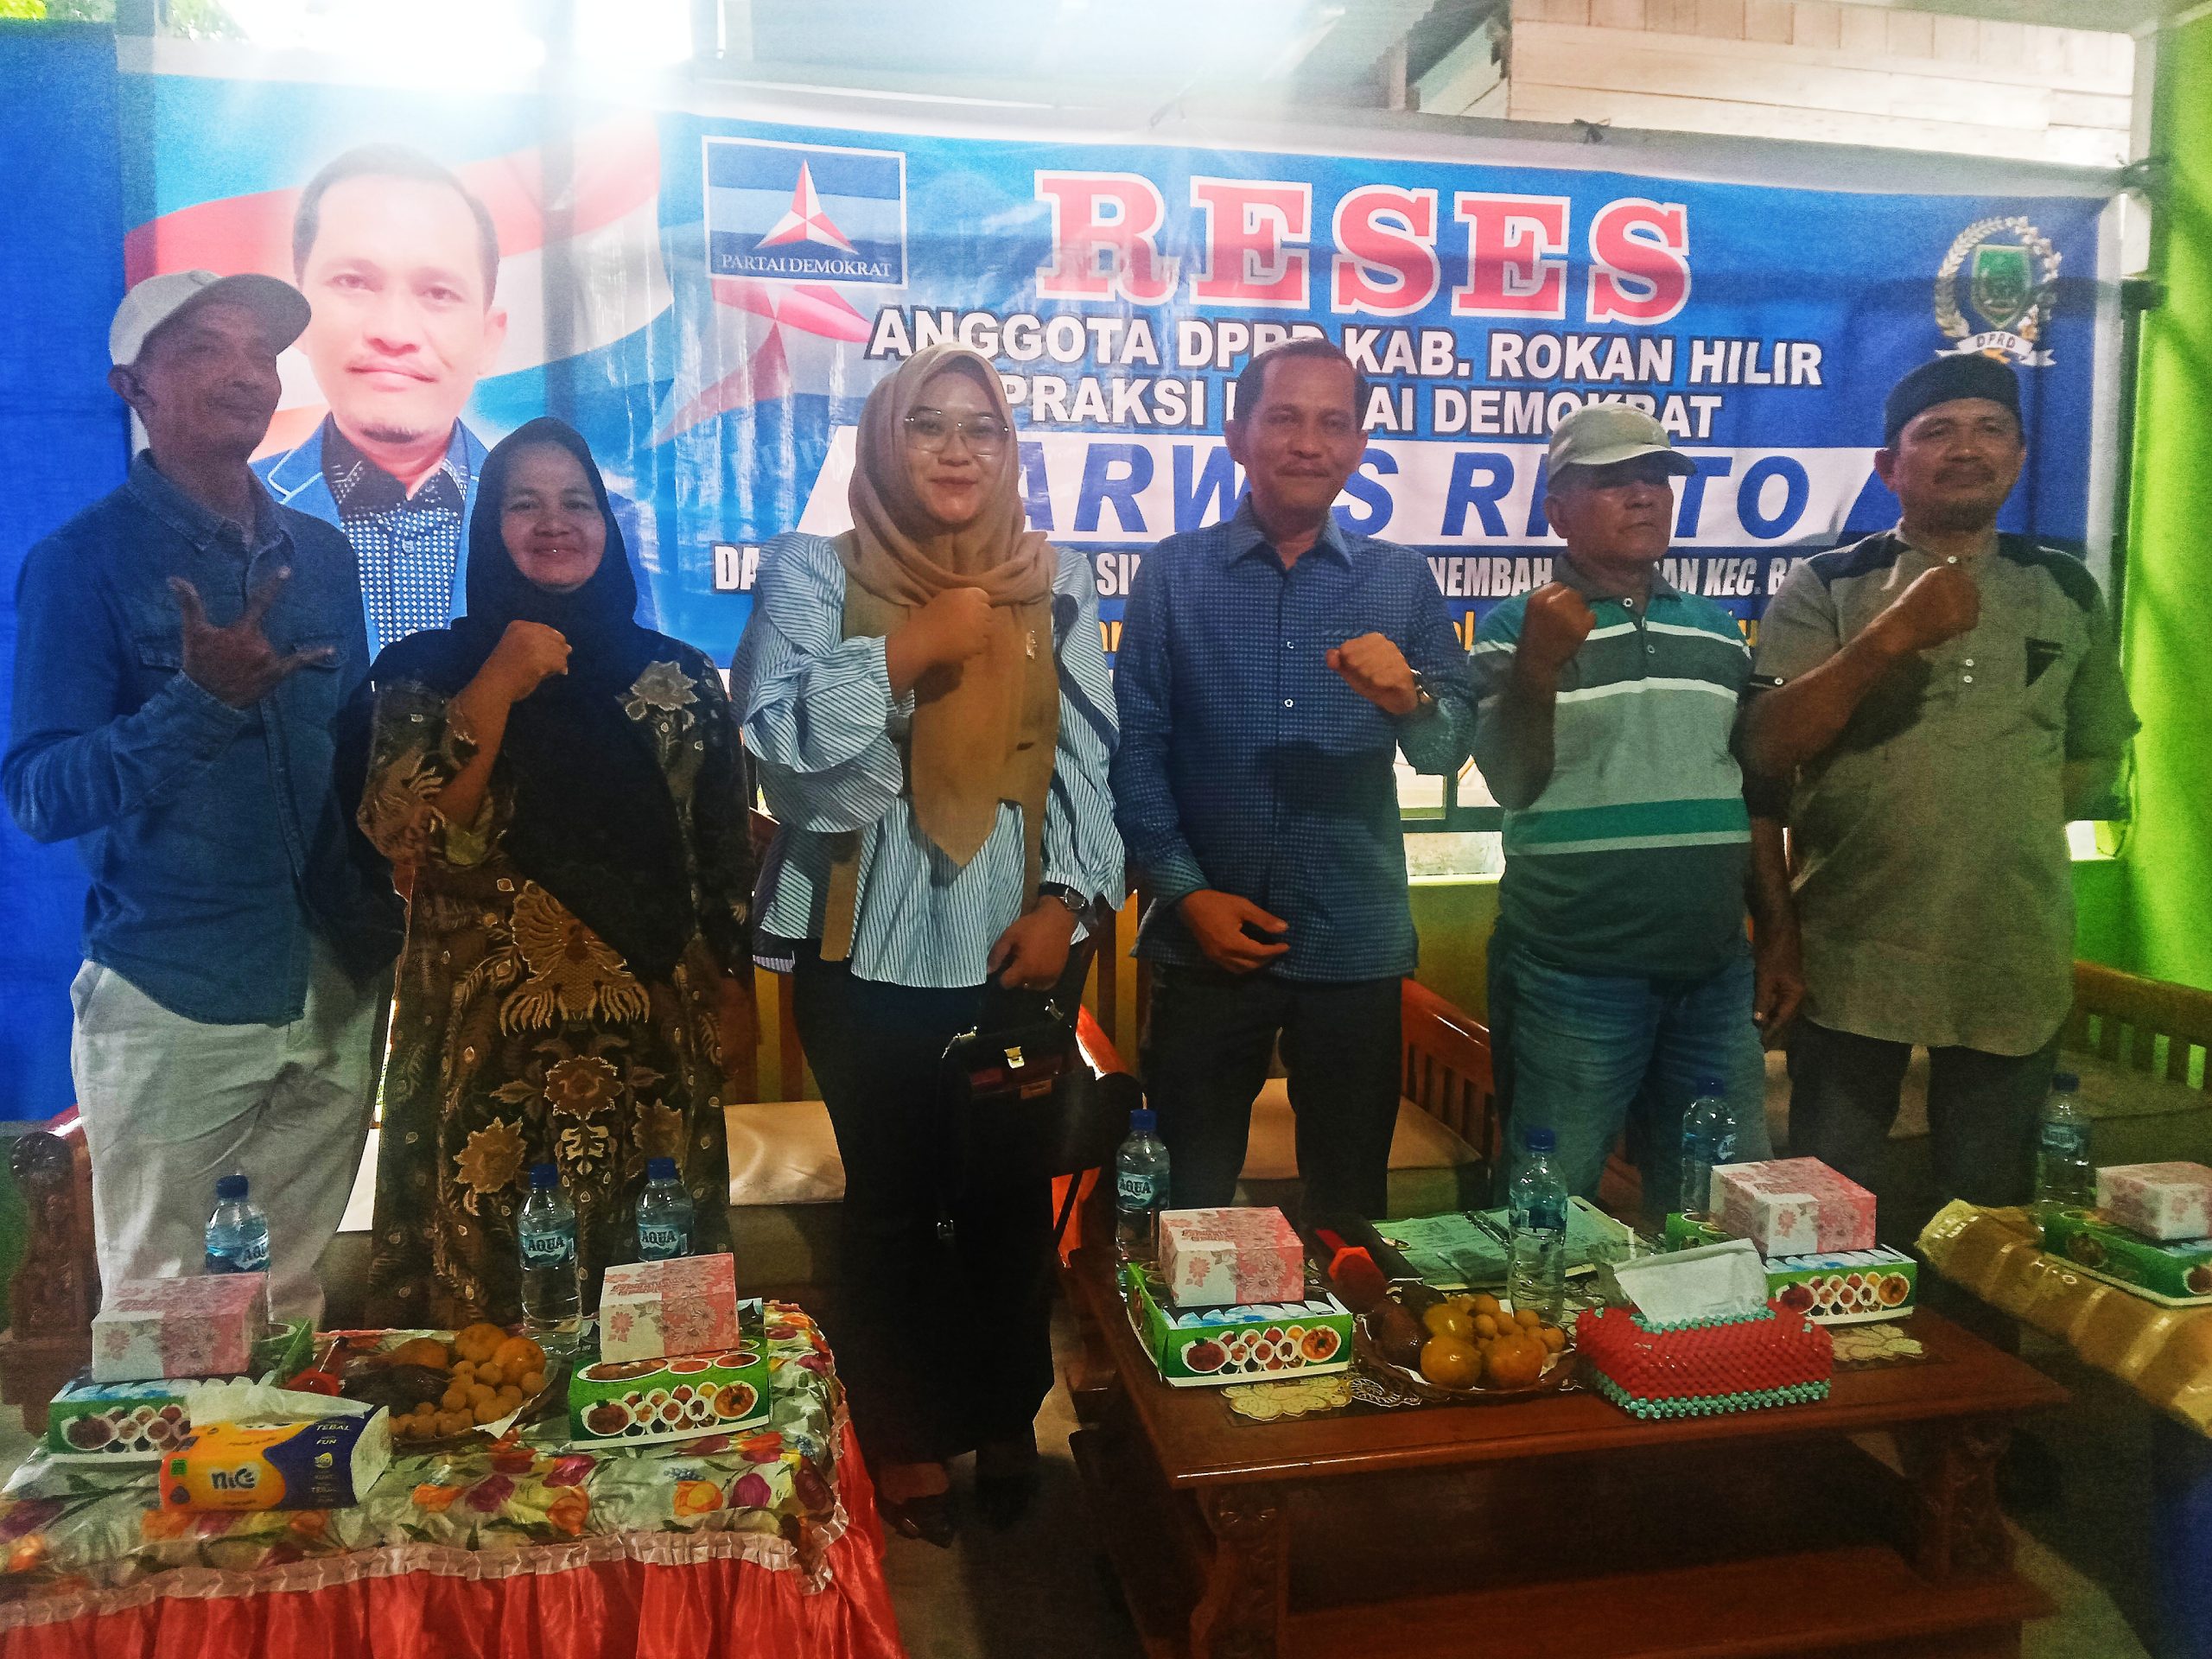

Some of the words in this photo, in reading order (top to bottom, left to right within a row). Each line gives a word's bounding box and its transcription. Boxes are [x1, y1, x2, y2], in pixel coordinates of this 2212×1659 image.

[1037, 169, 1691, 324] RESES
[721, 254, 785, 273] PARTAI
[788, 257, 893, 277] DEMOKRAT
[868, 307, 1161, 366] ANGGOTA
[1342, 326, 1471, 378] KAB.
[1488, 332, 1673, 383] ROKAN
[1689, 340, 1823, 386] HILIR
[1975, 332, 2016, 348] DPRD
[1427, 556, 1554, 597] NEMBAH
[1118, 1178, 1152, 1197] AQUA
[528, 1236, 566, 1253] AQUA
[640, 1230, 677, 1247] AQUA
